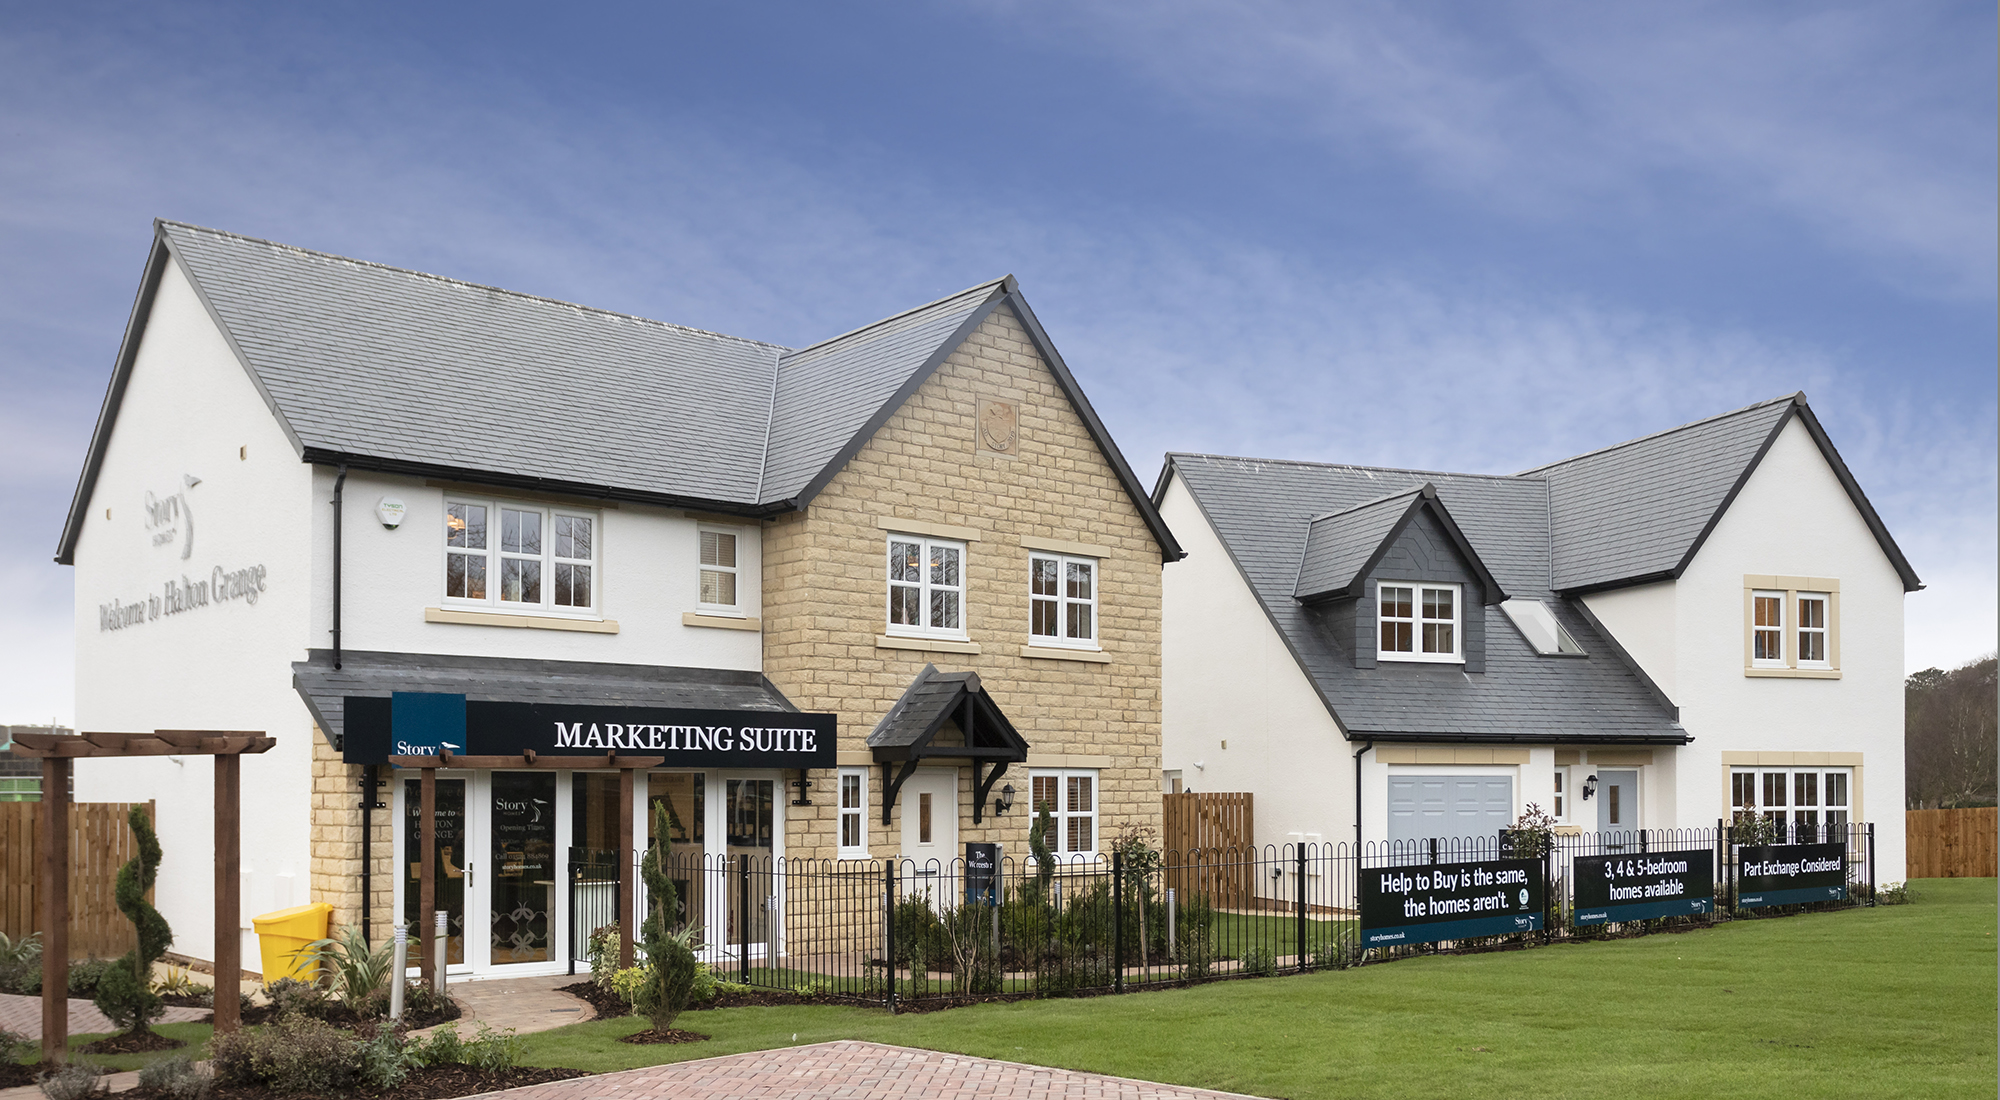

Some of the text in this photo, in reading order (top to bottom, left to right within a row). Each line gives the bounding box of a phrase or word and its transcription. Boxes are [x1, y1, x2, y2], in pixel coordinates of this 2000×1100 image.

[100, 563, 267, 633] Welcome to Halton Grange
[554, 722, 817, 752] MARKETING SUITE
[496, 798, 528, 814] Story
[414, 820, 454, 828] HTON
[500, 824, 526, 832] Opening
[413, 830, 454, 840] GNGE
[975, 851, 985, 859] The
[968, 860, 993, 869] Worcestr
[1604, 857, 1687, 880] 3, 4 & 5-bedroom
[1744, 856, 1840, 877] Part Exchange Considered
[1381, 867, 1528, 895] Help to Buy is the same,
[1609, 878, 1684, 900] homes available
[1404, 891, 1509, 918] the homes aren't.
[1370, 931, 1405, 942] storyhomes.co.uk
